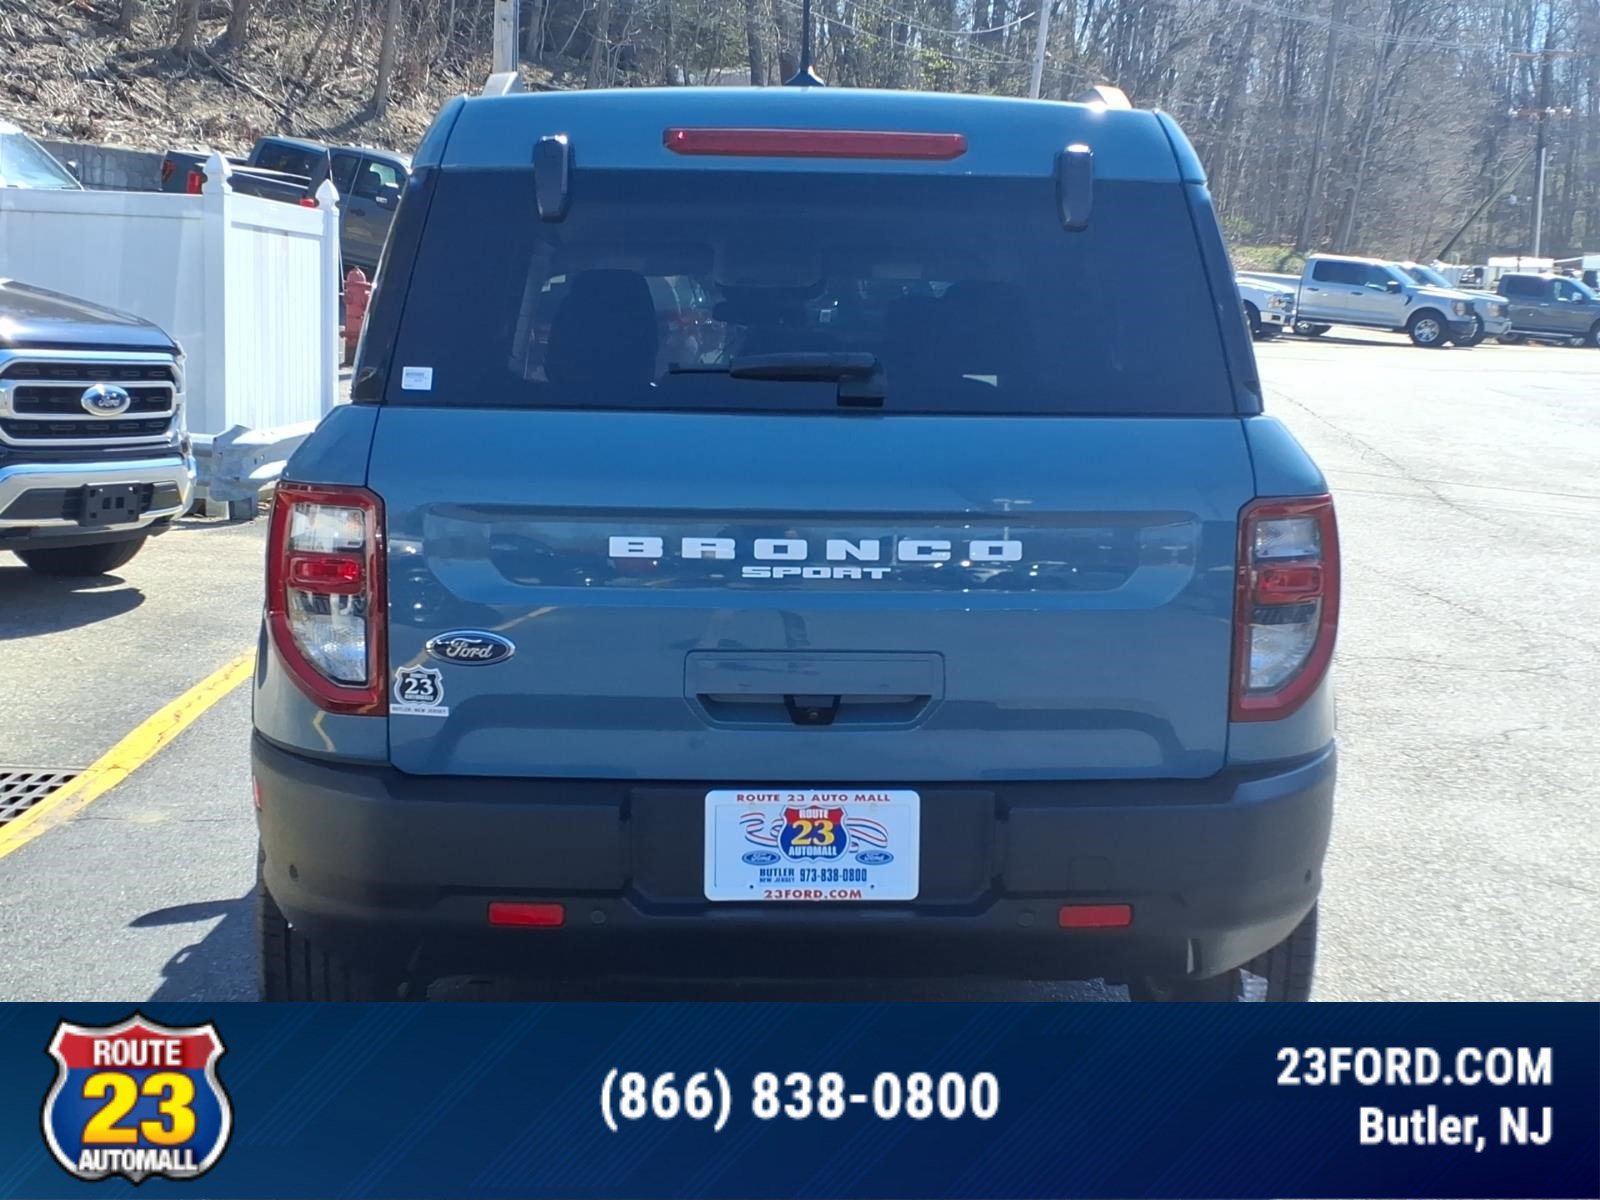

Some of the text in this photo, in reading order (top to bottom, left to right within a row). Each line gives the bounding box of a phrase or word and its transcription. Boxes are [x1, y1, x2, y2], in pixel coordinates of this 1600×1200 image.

[608, 536, 1023, 561] BRONCO
[741, 566, 892, 579] SPORT
[445, 637, 493, 658] Ford
[405, 678, 434, 695] 23
[736, 794, 891, 802] ROUTE 23 AUTO MALL
[799, 808, 829, 819] ROUTE
[791, 819, 835, 846] 23
[788, 846, 838, 857] AUTOMALL
[759, 868, 868, 882] BUTLER 973-838-0800
[763, 889, 862, 899] 23FORD.COM
